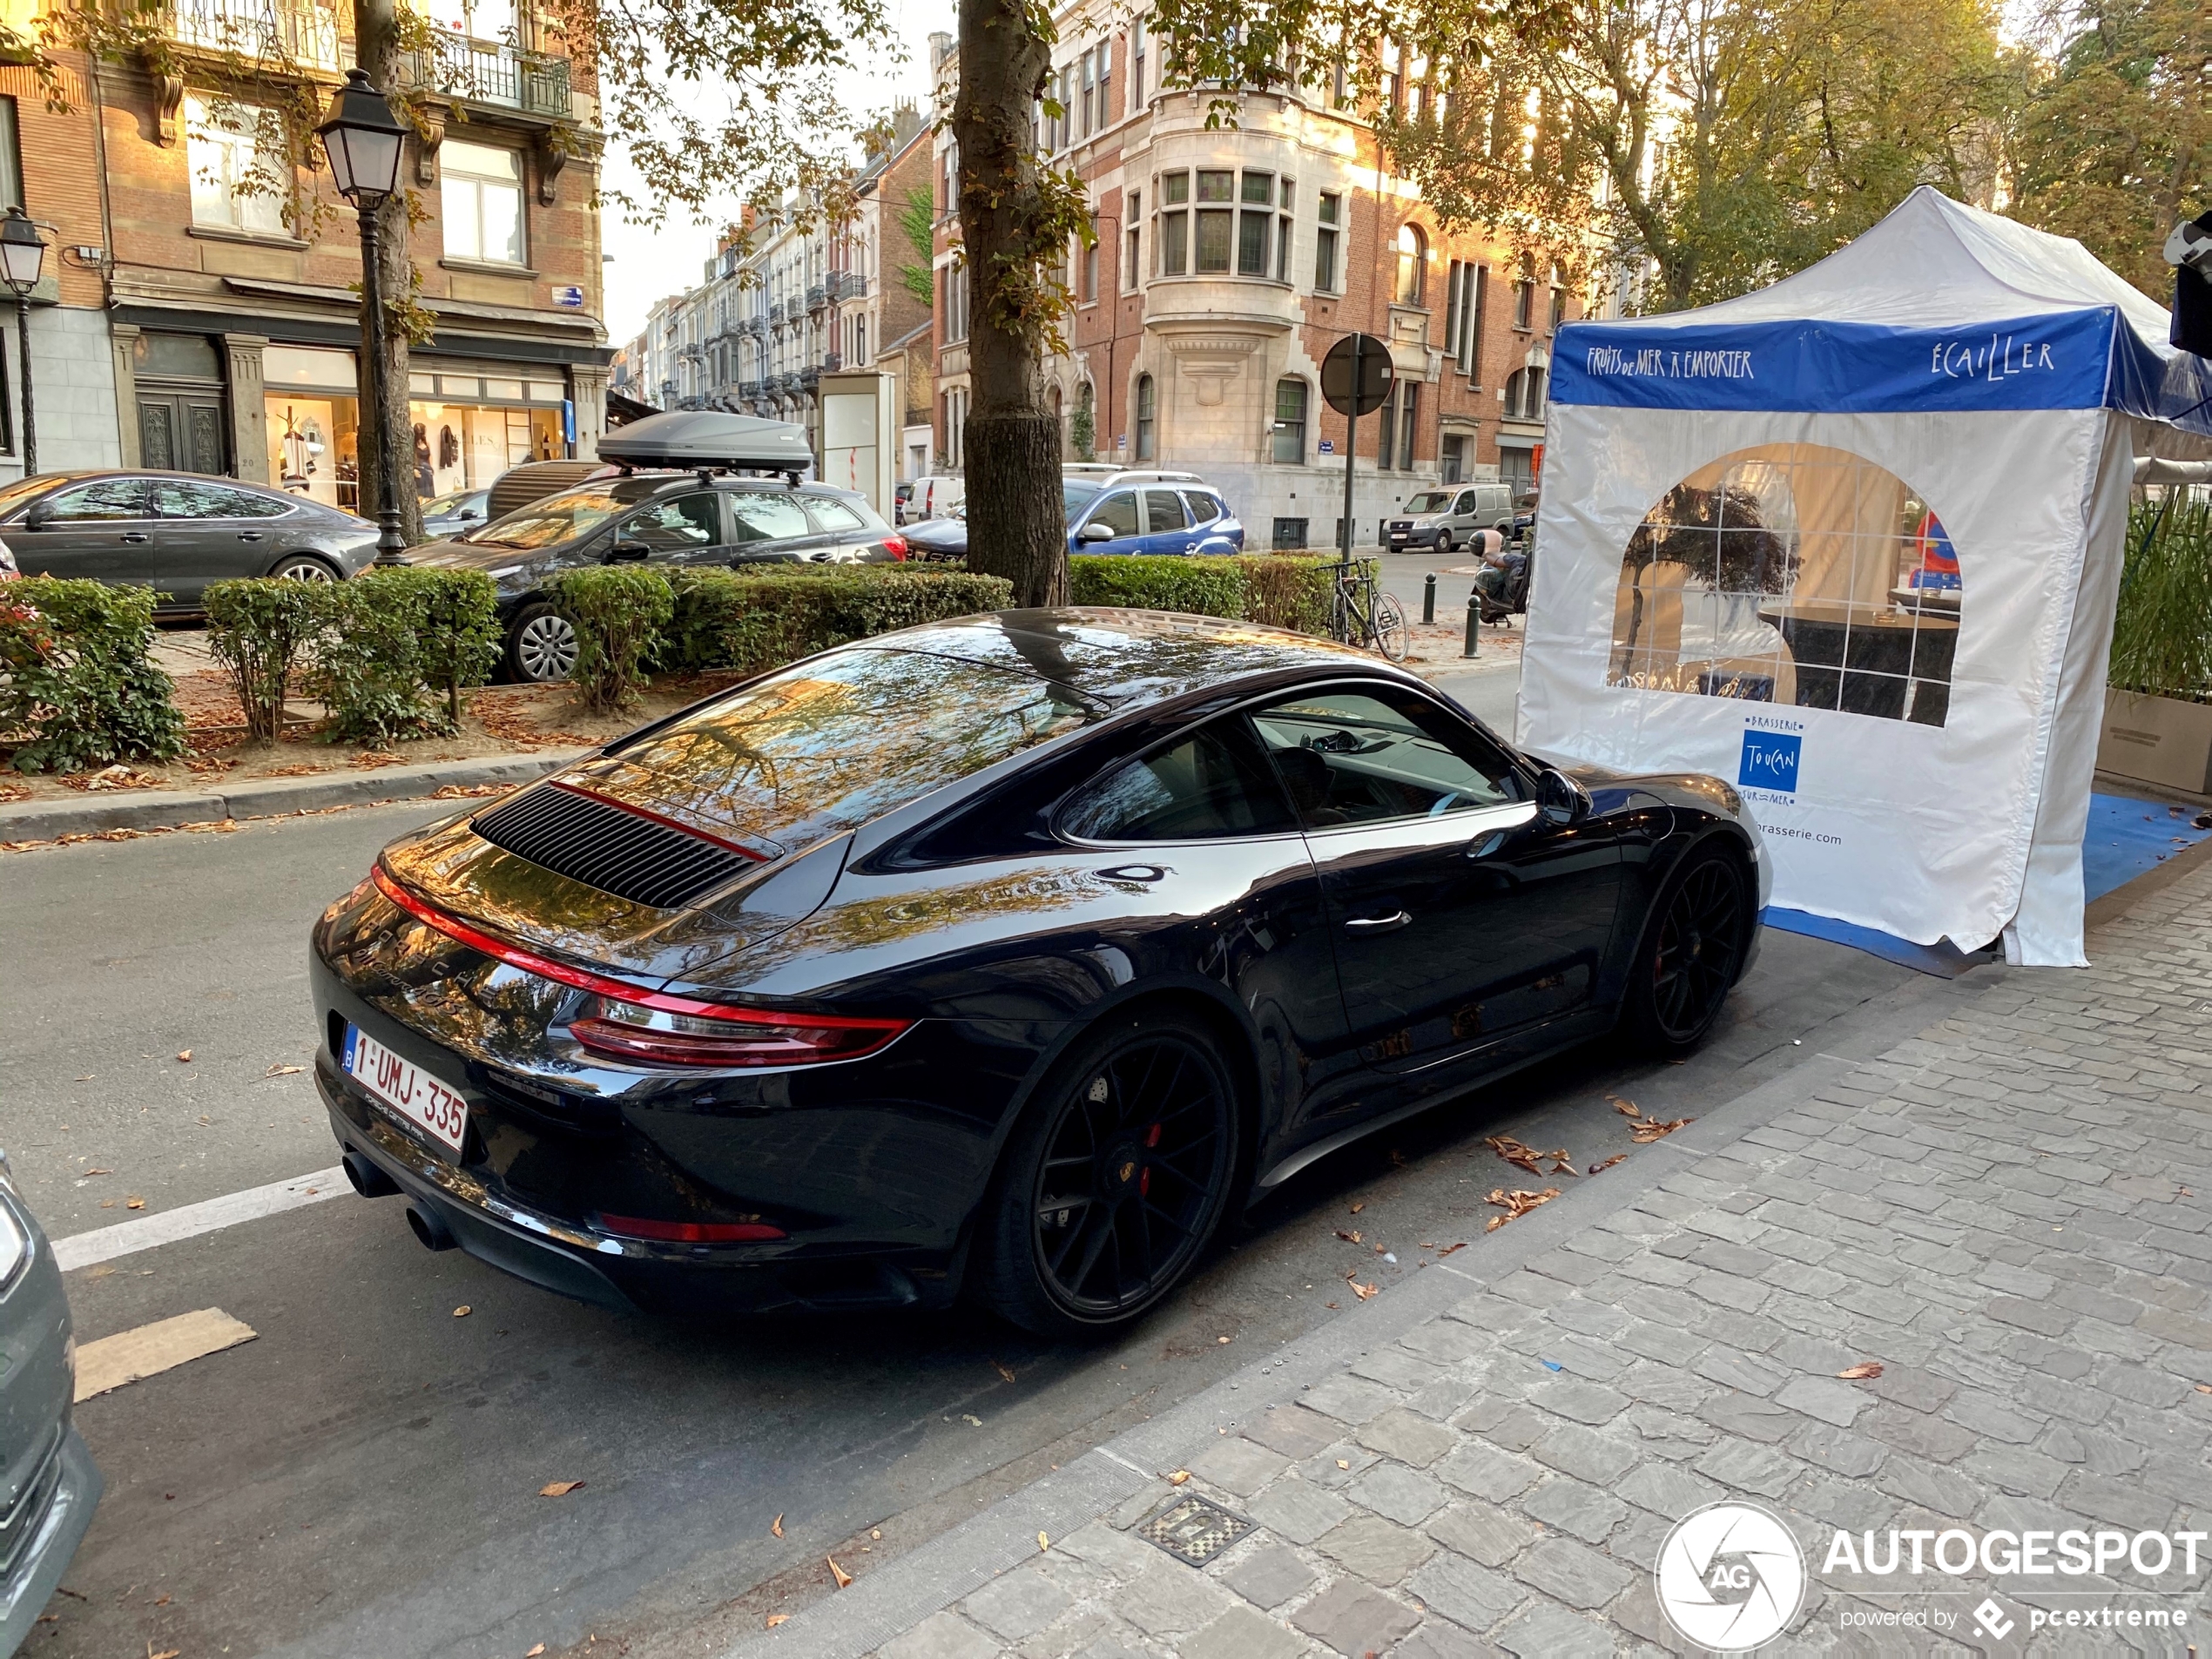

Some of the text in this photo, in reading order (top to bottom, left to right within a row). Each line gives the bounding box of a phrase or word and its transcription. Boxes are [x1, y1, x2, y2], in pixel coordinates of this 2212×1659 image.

[1635, 349, 1665, 377] MER
[1684, 350, 1755, 380] EMPORTER
[1931, 333, 2054, 381] ÉCAILLER
[243, 458, 253, 467] 20
[1751, 716, 1798, 732] BRASSERIE
[365, 920, 501, 997] PORSCHE
[345, 1049, 354, 1068] B
[364, 1093, 389, 1115] PORSCHE
